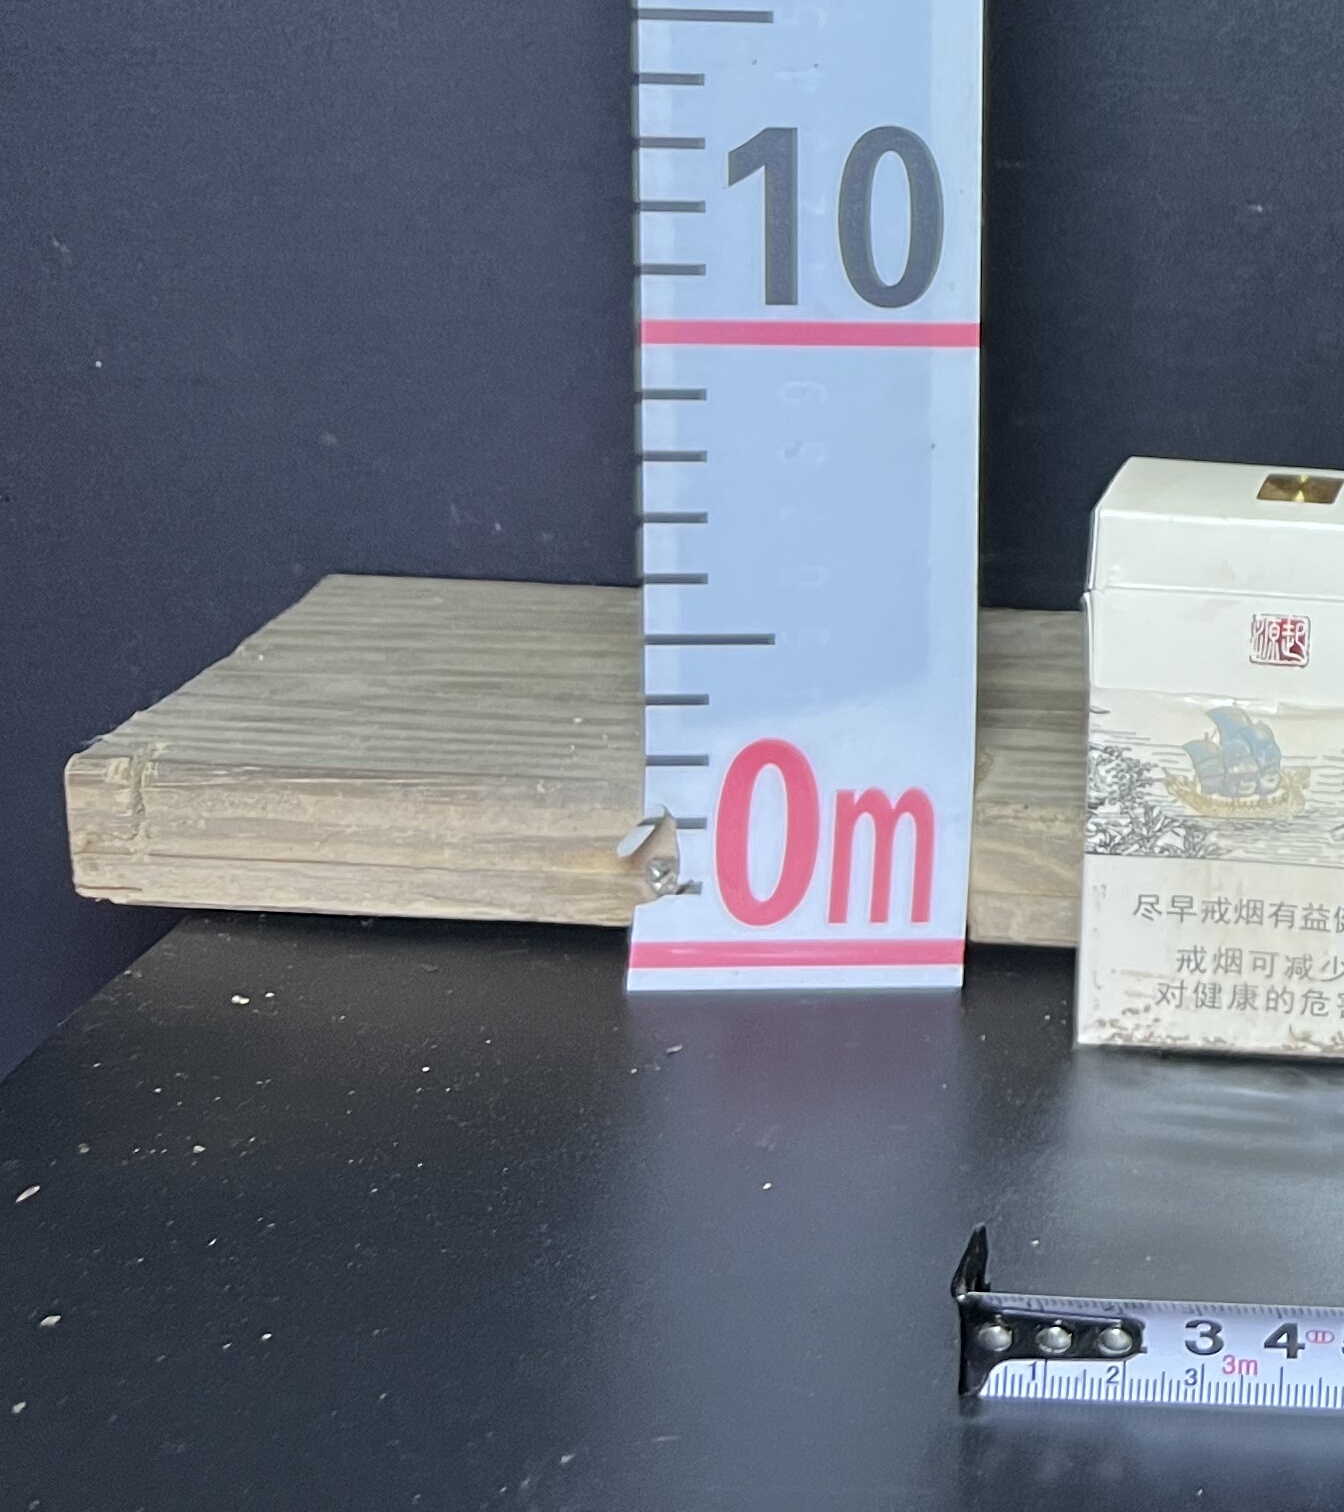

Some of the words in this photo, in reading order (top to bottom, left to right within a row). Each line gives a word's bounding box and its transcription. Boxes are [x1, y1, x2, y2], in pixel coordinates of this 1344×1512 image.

[727, 125, 944, 309] 10
[715, 739, 935, 926] 0m
[1184, 1319, 1224, 1356] 3
[1263, 1323, 1306, 1359] 4
[1106, 1365, 1120, 1385] 2
[1184, 1368, 1198, 1386] 3
[1222, 1355, 1259, 1376] 3m
